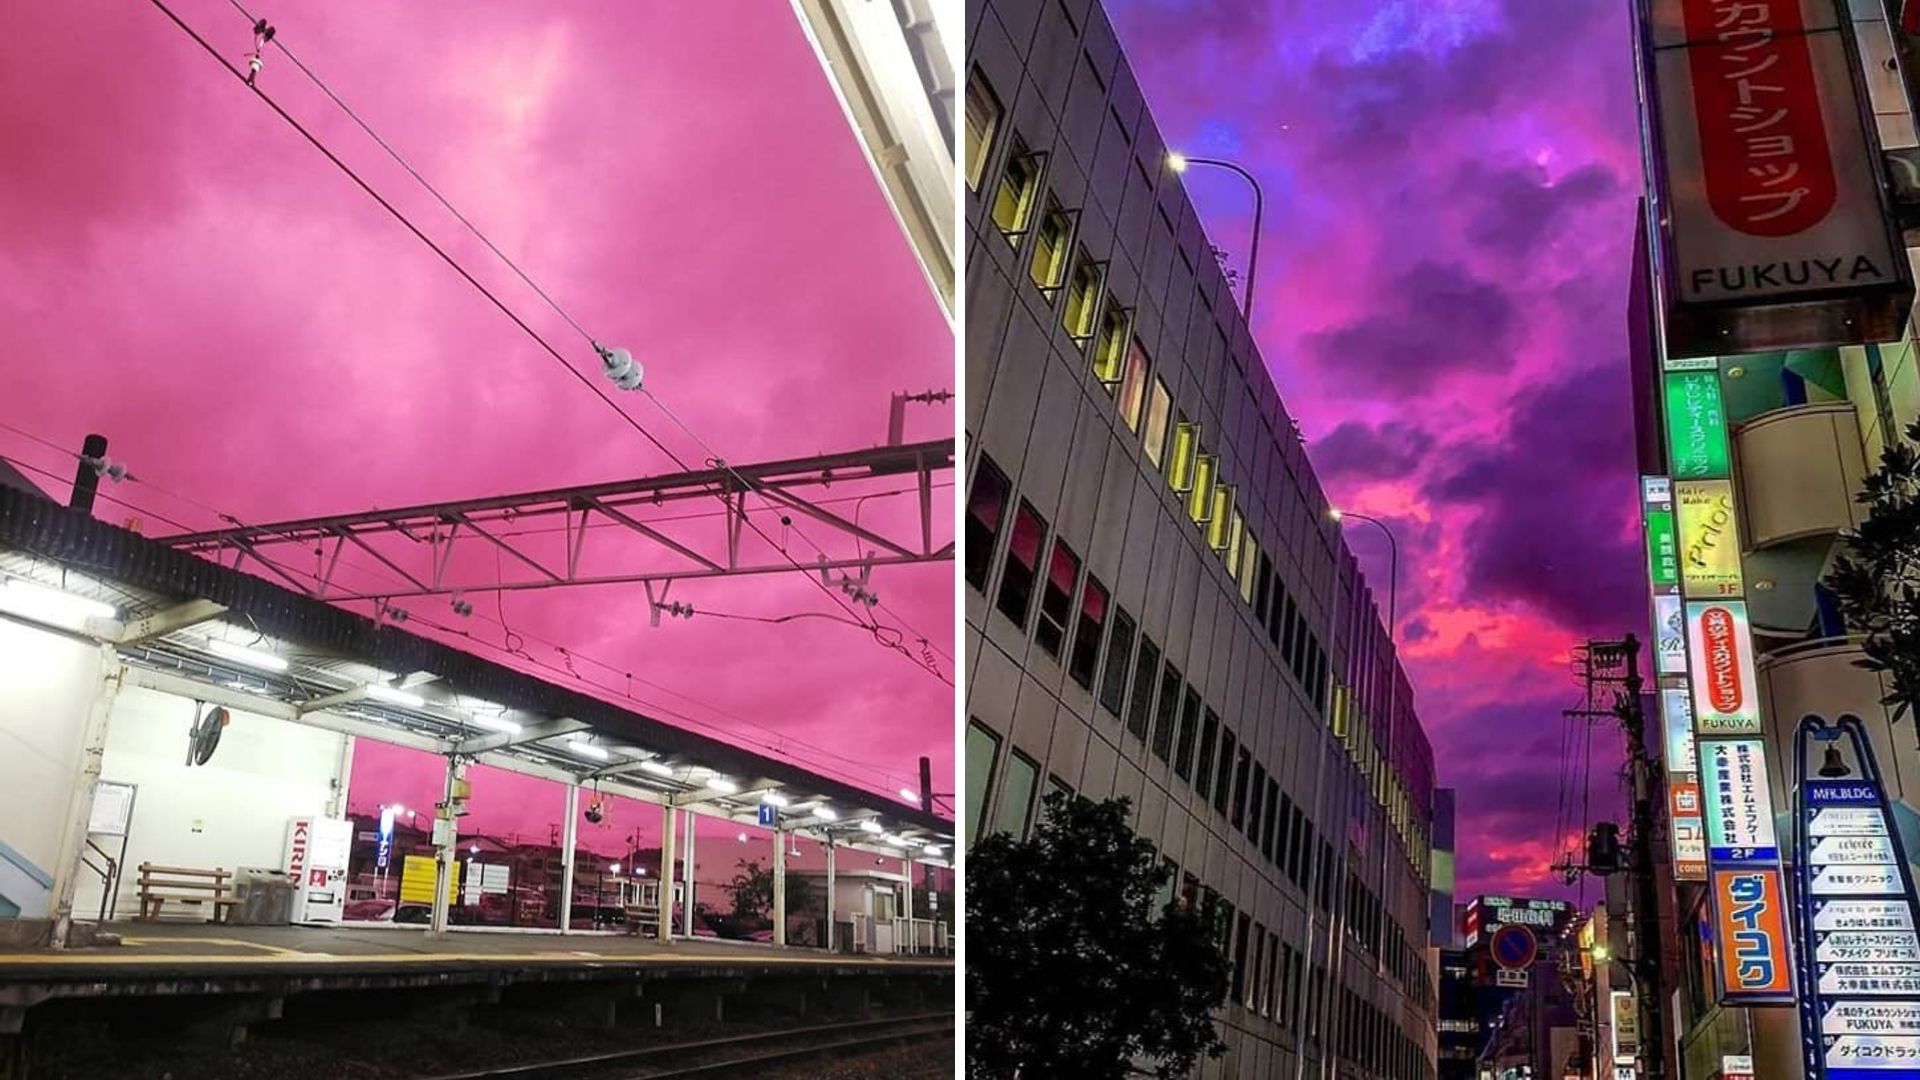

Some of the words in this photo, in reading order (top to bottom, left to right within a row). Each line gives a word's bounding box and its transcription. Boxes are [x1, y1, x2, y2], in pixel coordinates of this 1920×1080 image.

[1713, 0, 1810, 222] カウントショップ
[1691, 254, 1882, 294] FUKUYA
[1702, 718, 1755, 729] FUKUYA
[762, 806, 771, 823] 1
[288, 821, 308, 891] KIRIN
[1731, 848, 1755, 860] 2F
[1728, 873, 1774, 989] ダイコク
[1829, 948, 1871, 959] ヘアメイク
[1835, 965, 1869, 976] 株式会社
[1846, 1019, 1894, 1030] FUKUYA
[1839, 1045, 1920, 1059] ダイコクドラッ
